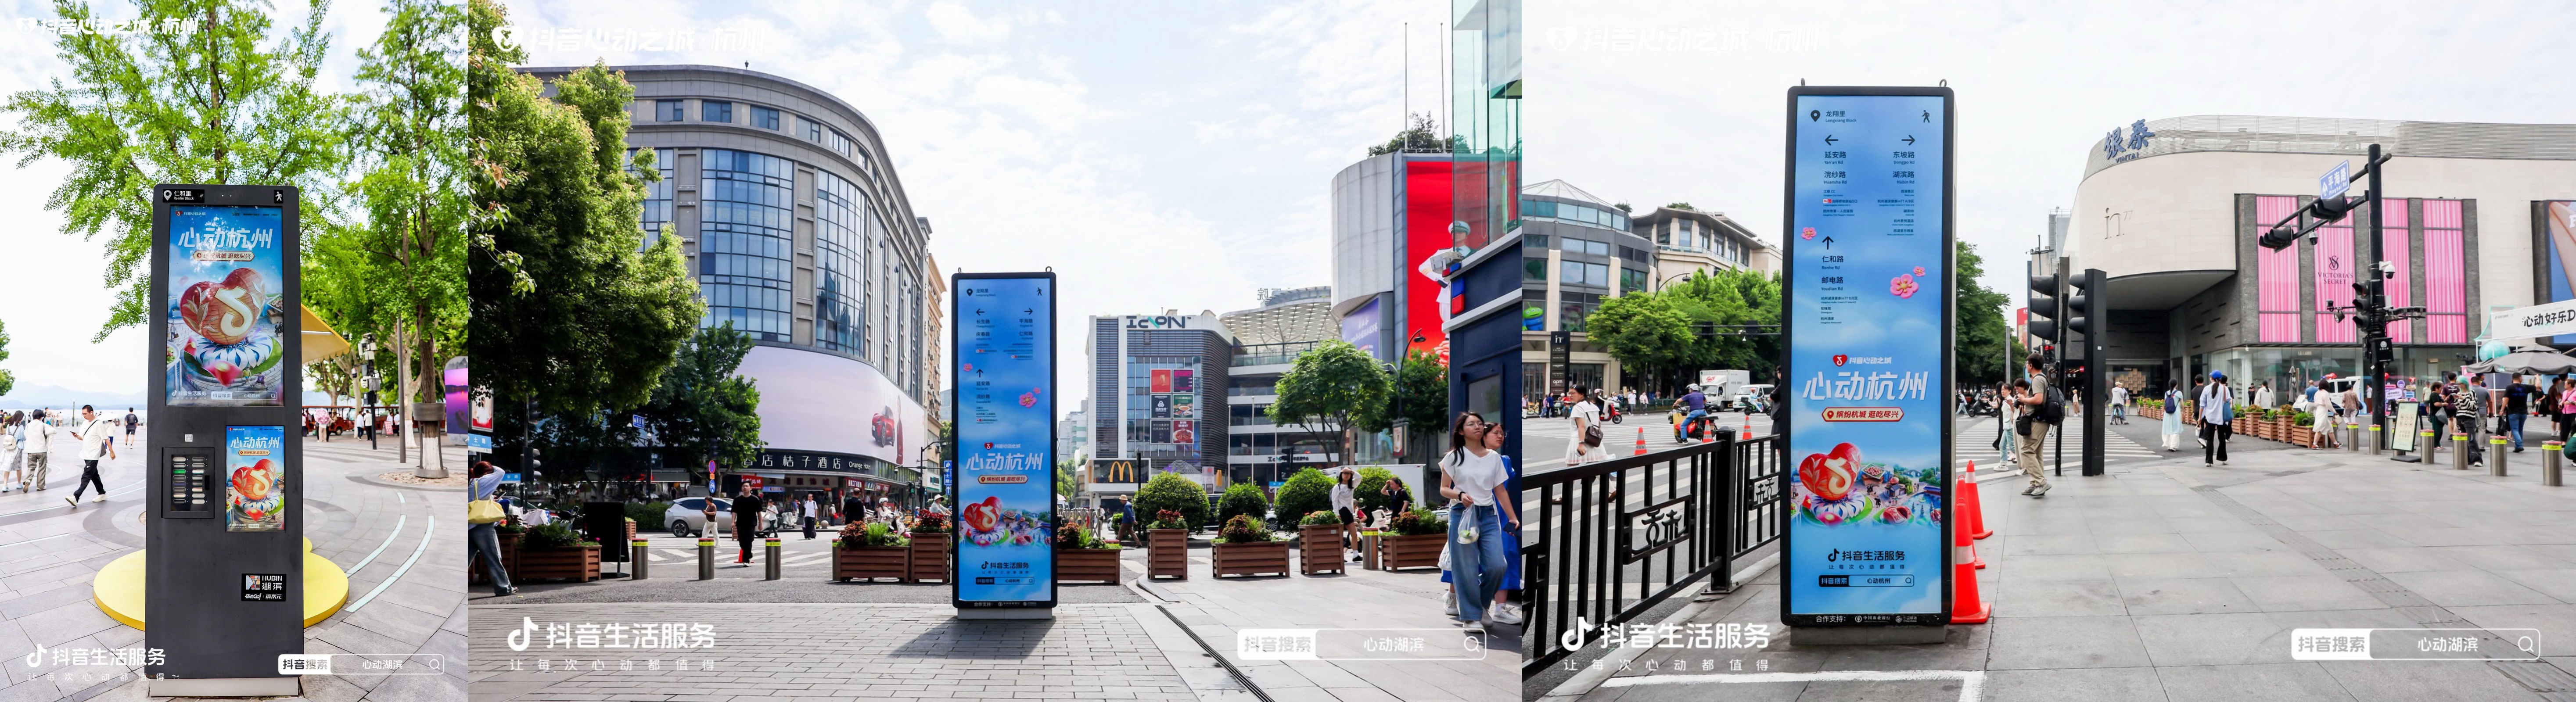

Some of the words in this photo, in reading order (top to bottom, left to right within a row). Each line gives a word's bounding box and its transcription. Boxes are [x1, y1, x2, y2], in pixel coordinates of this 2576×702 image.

[2103, 118, 2155, 160] 银泰
[2116, 152, 2139, 163] YINTAI
[2328, 167, 2346, 189] 平海路
[2329, 184, 2342, 196] Pinghai
[2342, 180, 2347, 189] Rd
[178, 227, 273, 249] 心动杭州
[1802, 371, 1929, 401] 心动杭州
[230, 437, 280, 448] 心动杭州
[849, 461, 863, 469] Orange
[966, 453, 1043, 471] 心动杭州
[1842, 551, 1905, 561] 抖音生活服务
